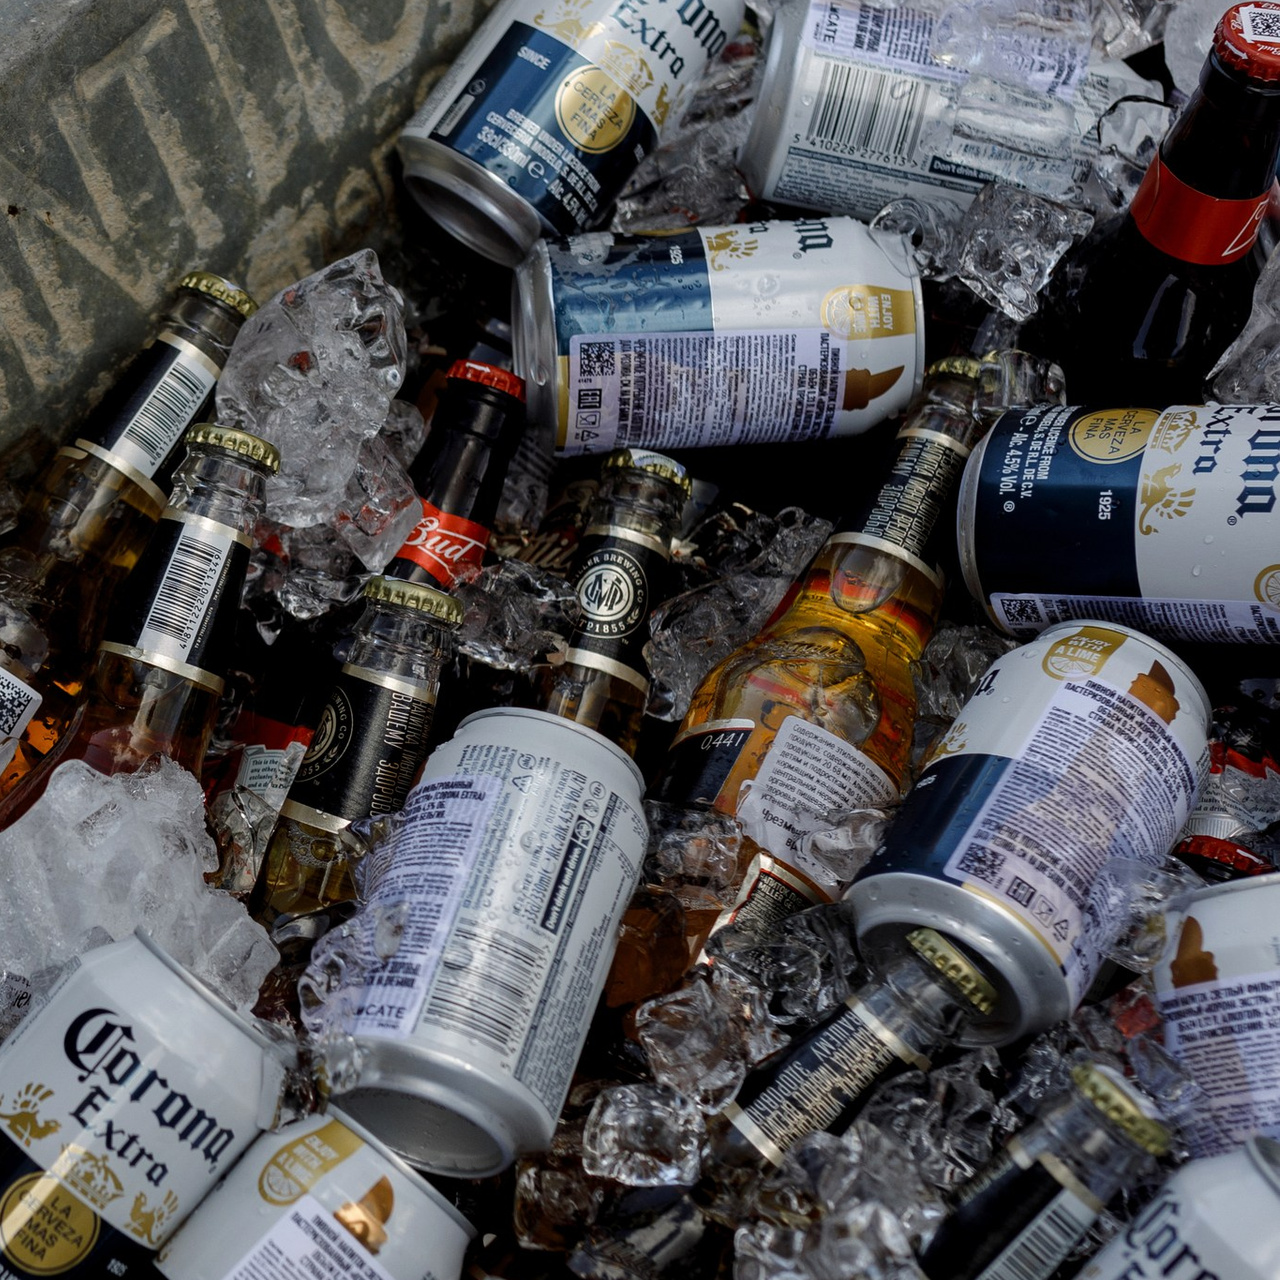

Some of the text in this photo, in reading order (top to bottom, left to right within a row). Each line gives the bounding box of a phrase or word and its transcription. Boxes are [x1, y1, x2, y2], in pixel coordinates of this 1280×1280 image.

[516, 44, 551, 71] SINCE
[572, 80, 624, 129] CERVEZA
[599, 85, 618, 103] LA
[484, 110, 534, 147] CERVECERIA
[570, 112, 598, 141] FINA
[579, 102, 606, 130] MAS
[475, 124, 530, 168] 33cl/330ml
[504, 107, 589, 178] BREWED UNDER LICENCE
[809, 136, 855, 155] 410228
[932, 159, 956, 173] Don't
[956, 165, 979, 178] drink
[668, 244, 683, 265] 1925
[868, 295, 879, 328] WITH
[880, 292, 892, 329] ENJOY
[1083, 417, 1101, 439] FINA
[1099, 418, 1117, 439] MAS
[1107, 410, 1136, 453] CERVEZA
[1130, 421, 1145, 434] LA
[998, 430, 1027, 495] Alc. 4.5% Vol.
[1019, 439, 1043, 498] DE R.L. DE C.V.
[1035, 426, 1061, 480] LICENCE FROM
[866, 437, 926, 536] ВАШЕМУ ЗДОРОВЬЮ
[897, 476, 927, 513] ПИВНОГО
[1097, 489, 1112, 520] 1925
[405, 514, 474, 563] Bud
[599, 552, 645, 586] BREWING
[182, 596, 205, 639] 811222
[201, 552, 223, 598] 011349
[594, 616, 626, 636] 1855
[1063, 647, 1100, 665] LIME
[1064, 680, 1136, 722] ПАСТЕРИЗОВАННЫЙ
[1084, 678, 1118, 699] ПИВНОЙ
[384, 692, 412, 749] ВАШЕМУ
[1086, 709, 1116, 732] СТРАНА
[1095, 703, 1123, 725] ОБЪЕМ
[1119, 718, 1137, 736] 0,33
[523, 872, 552, 924] 33cl/330ml
[545, 822, 570, 860] Alc./alk.
[565, 771, 588, 802] Vol./til
[543, 844, 583, 929] Don't drink and drive.
[65, 1010, 234, 1172] Corona
[69, 1084, 169, 1187] Extra
[18, 1186, 83, 1247] CERVEZA
[49, 1195, 73, 1218] LA
[12, 1229, 48, 1261] FINA
[23, 1217, 59, 1248] MAS
